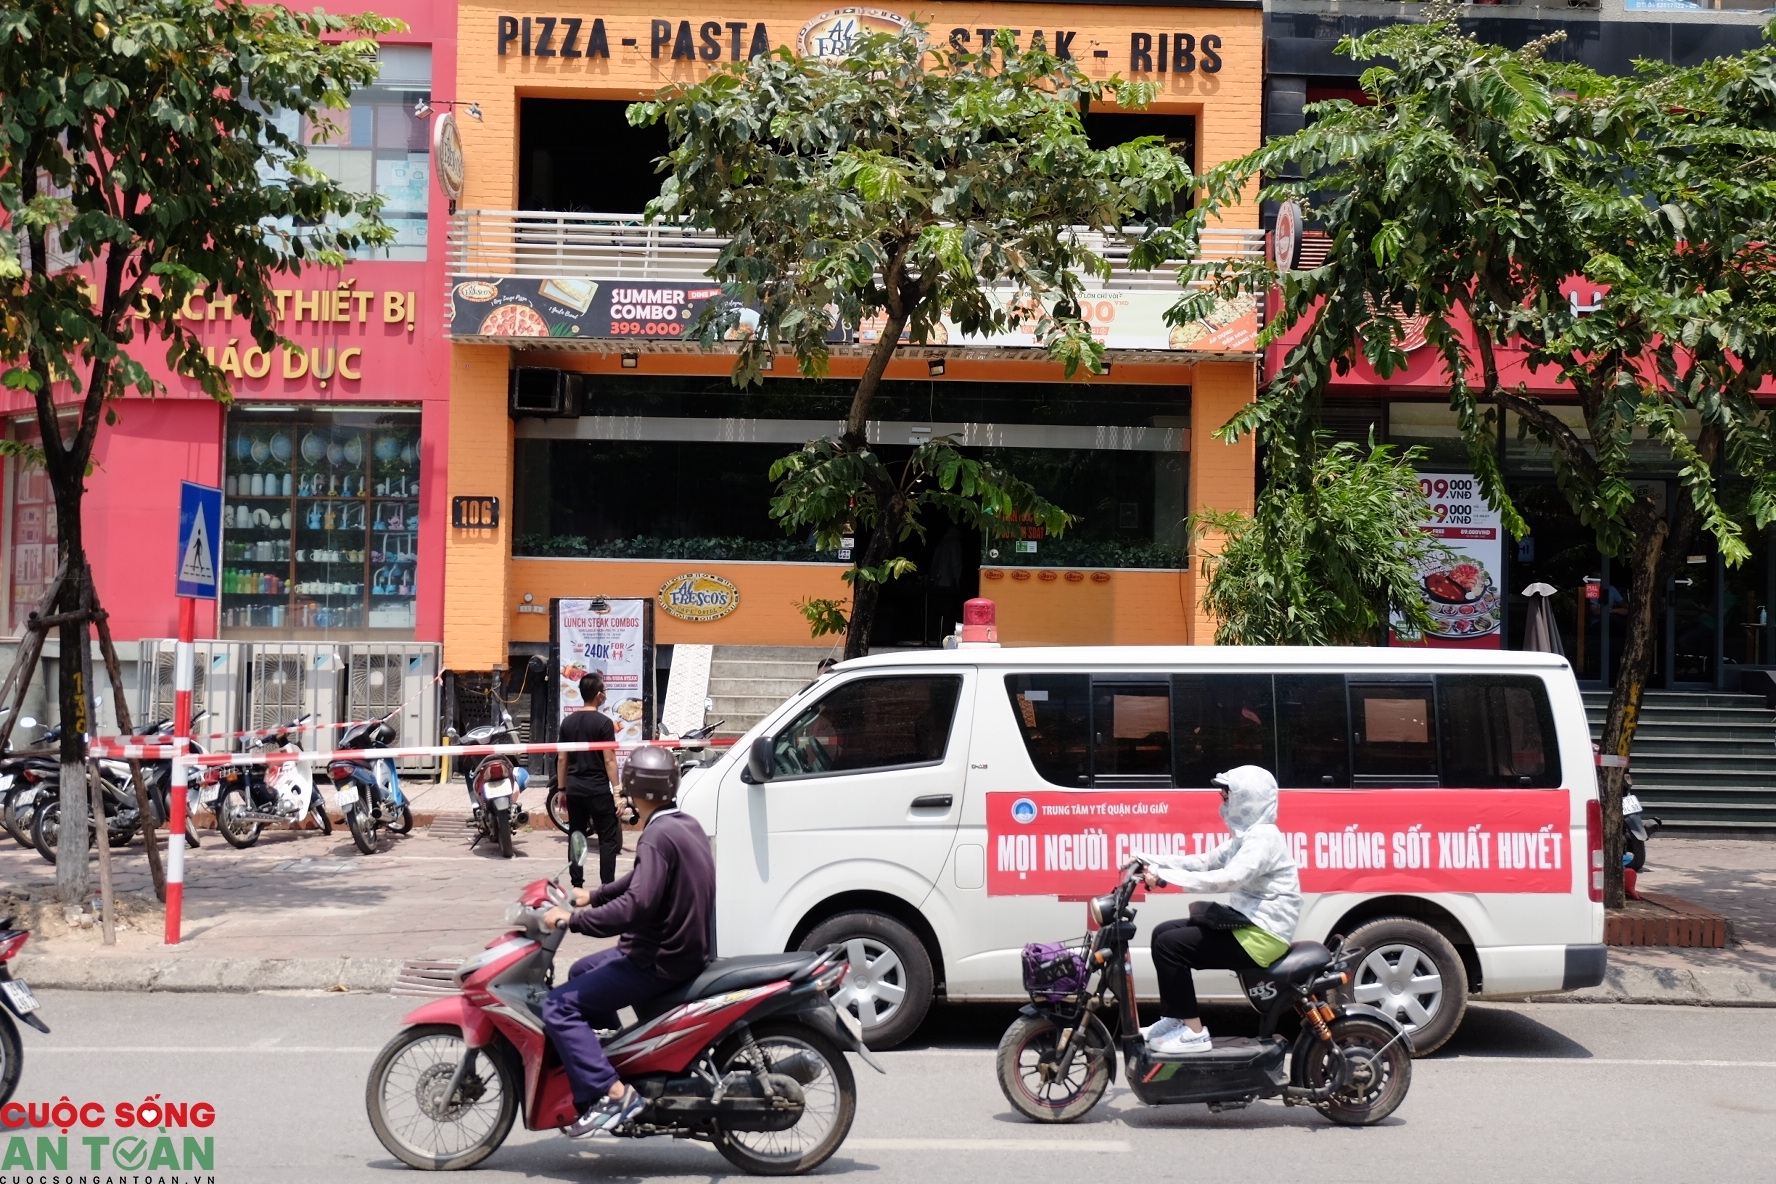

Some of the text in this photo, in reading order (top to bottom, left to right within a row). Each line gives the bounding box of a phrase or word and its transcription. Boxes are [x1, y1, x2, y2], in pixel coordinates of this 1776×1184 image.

[498, 16, 610, 59] PIZZA
[651, 19, 770, 62] PASTA
[1130, 32, 1223, 73] RIBS
[611, 288, 685, 304] SUMMER
[691, 291, 708, 299] DINE
[134, 287, 233, 321] SCH
[272, 278, 374, 323] THIẾT
[383, 291, 416, 332] BỊ
[610, 305, 677, 320] COMBO
[610, 322, 680, 335] 399.000
[282, 347, 362, 389] DỤC
[1449, 480, 1472, 490] 000
[1450, 491, 1472, 499] VNĐ
[459, 500, 492, 525] 106
[1449, 504, 1472, 515] 000
[1449, 516, 1472, 524] VNĐ
[564, 617, 639, 628] LUNCH STEAK COMBOS
[584, 643, 610, 659] 240K
[1042, 805, 1070, 815] TRUNG
[1071, 804, 1089, 815] TÂM
[1089, 805, 1096, 815] Y
[1096, 802, 1107, 815] TẾ
[1107, 803, 1131, 817] QUẬN
[1149, 802, 1169, 814] GIẤY
[997, 834, 1037, 880] MỌI
[1044, 828, 1108, 871] NGƯỜI
[1116, 833, 1186, 870] CHUNG
[1315, 824, 1386, 869] CHỐNG
[1392, 824, 1431, 869] SỐT
[1438, 824, 1491, 869] XUẤT
[1498, 824, 1563, 870] HUYẾT
